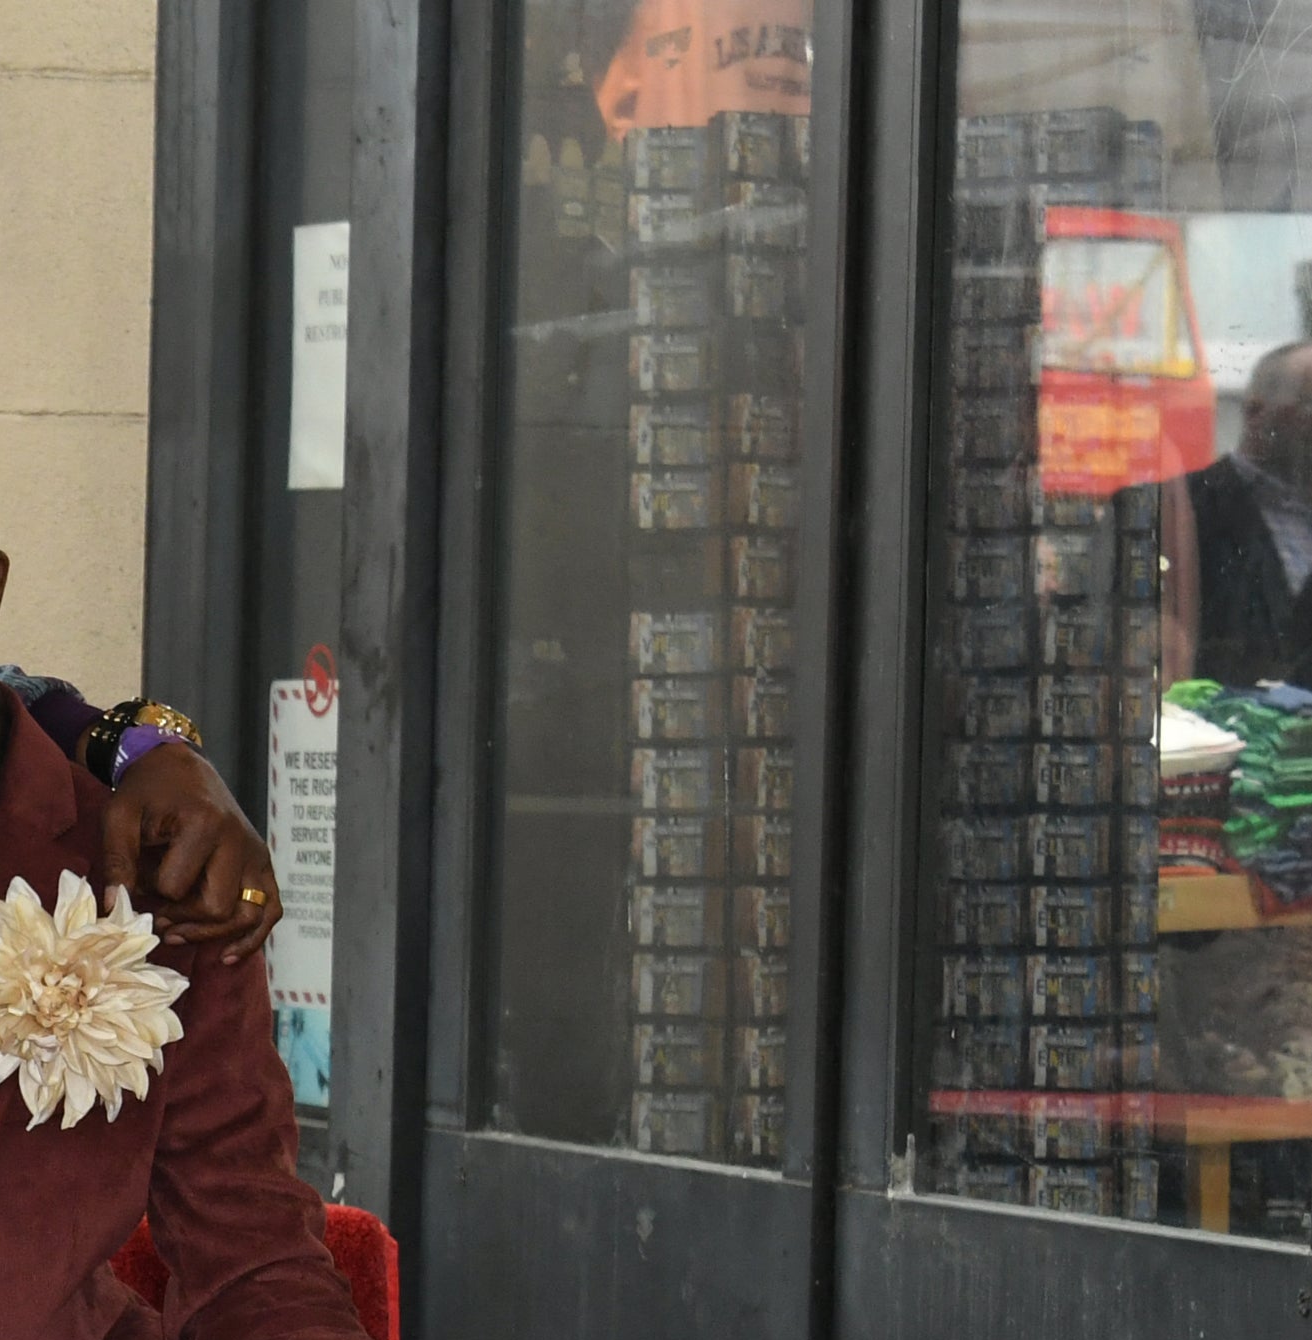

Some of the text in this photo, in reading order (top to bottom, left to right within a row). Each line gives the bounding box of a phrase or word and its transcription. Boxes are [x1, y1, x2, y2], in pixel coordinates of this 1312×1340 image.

[284, 752, 337, 770] WE RESER
[290, 778, 336, 796] THE RIGH
[293, 804, 336, 821] TO REFUS
[291, 827, 329, 843] SERVICE
[296, 849, 332, 866] ANYONE
